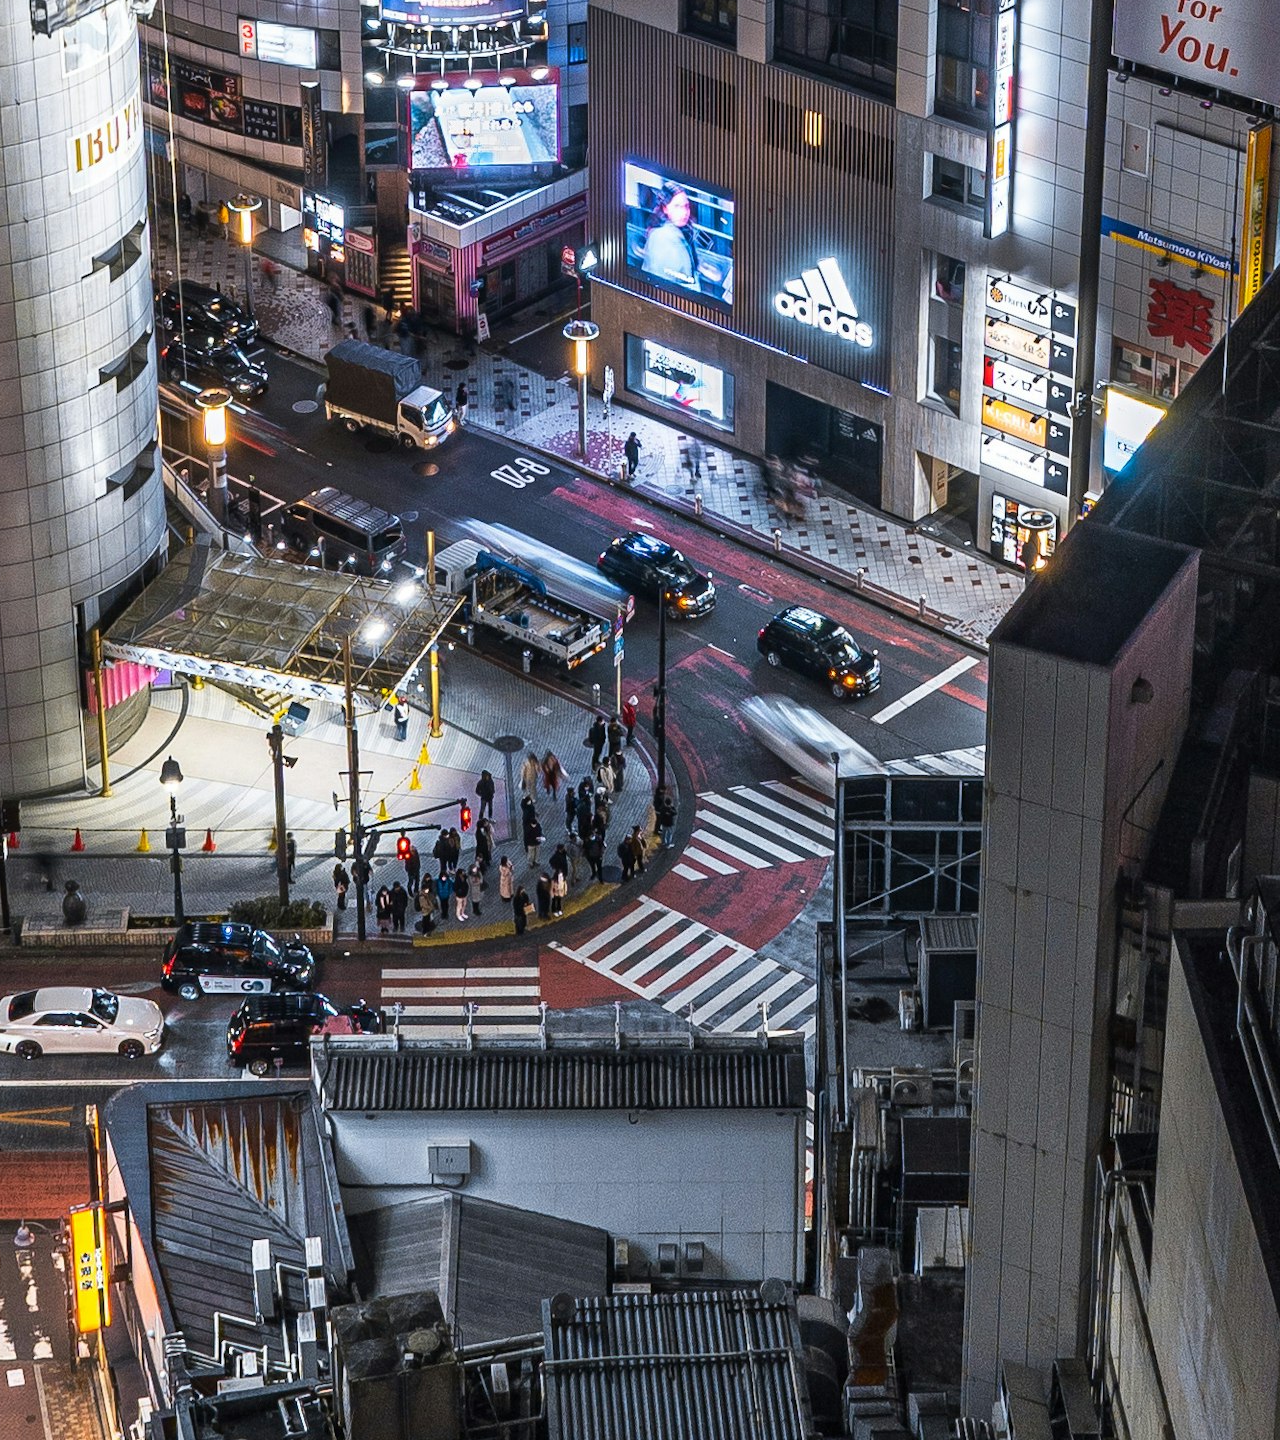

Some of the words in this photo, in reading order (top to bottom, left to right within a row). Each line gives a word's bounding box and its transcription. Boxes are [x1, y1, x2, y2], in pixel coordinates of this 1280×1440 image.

[242, 24, 253, 53] 3F
[1252, 178, 1265, 236] KiYoshi
[1137, 230, 1196, 259] Matsumoto
[774, 291, 874, 348] adidas
[1147, 277, 1216, 356] 薬
[996, 371, 1043, 394] スシロー
